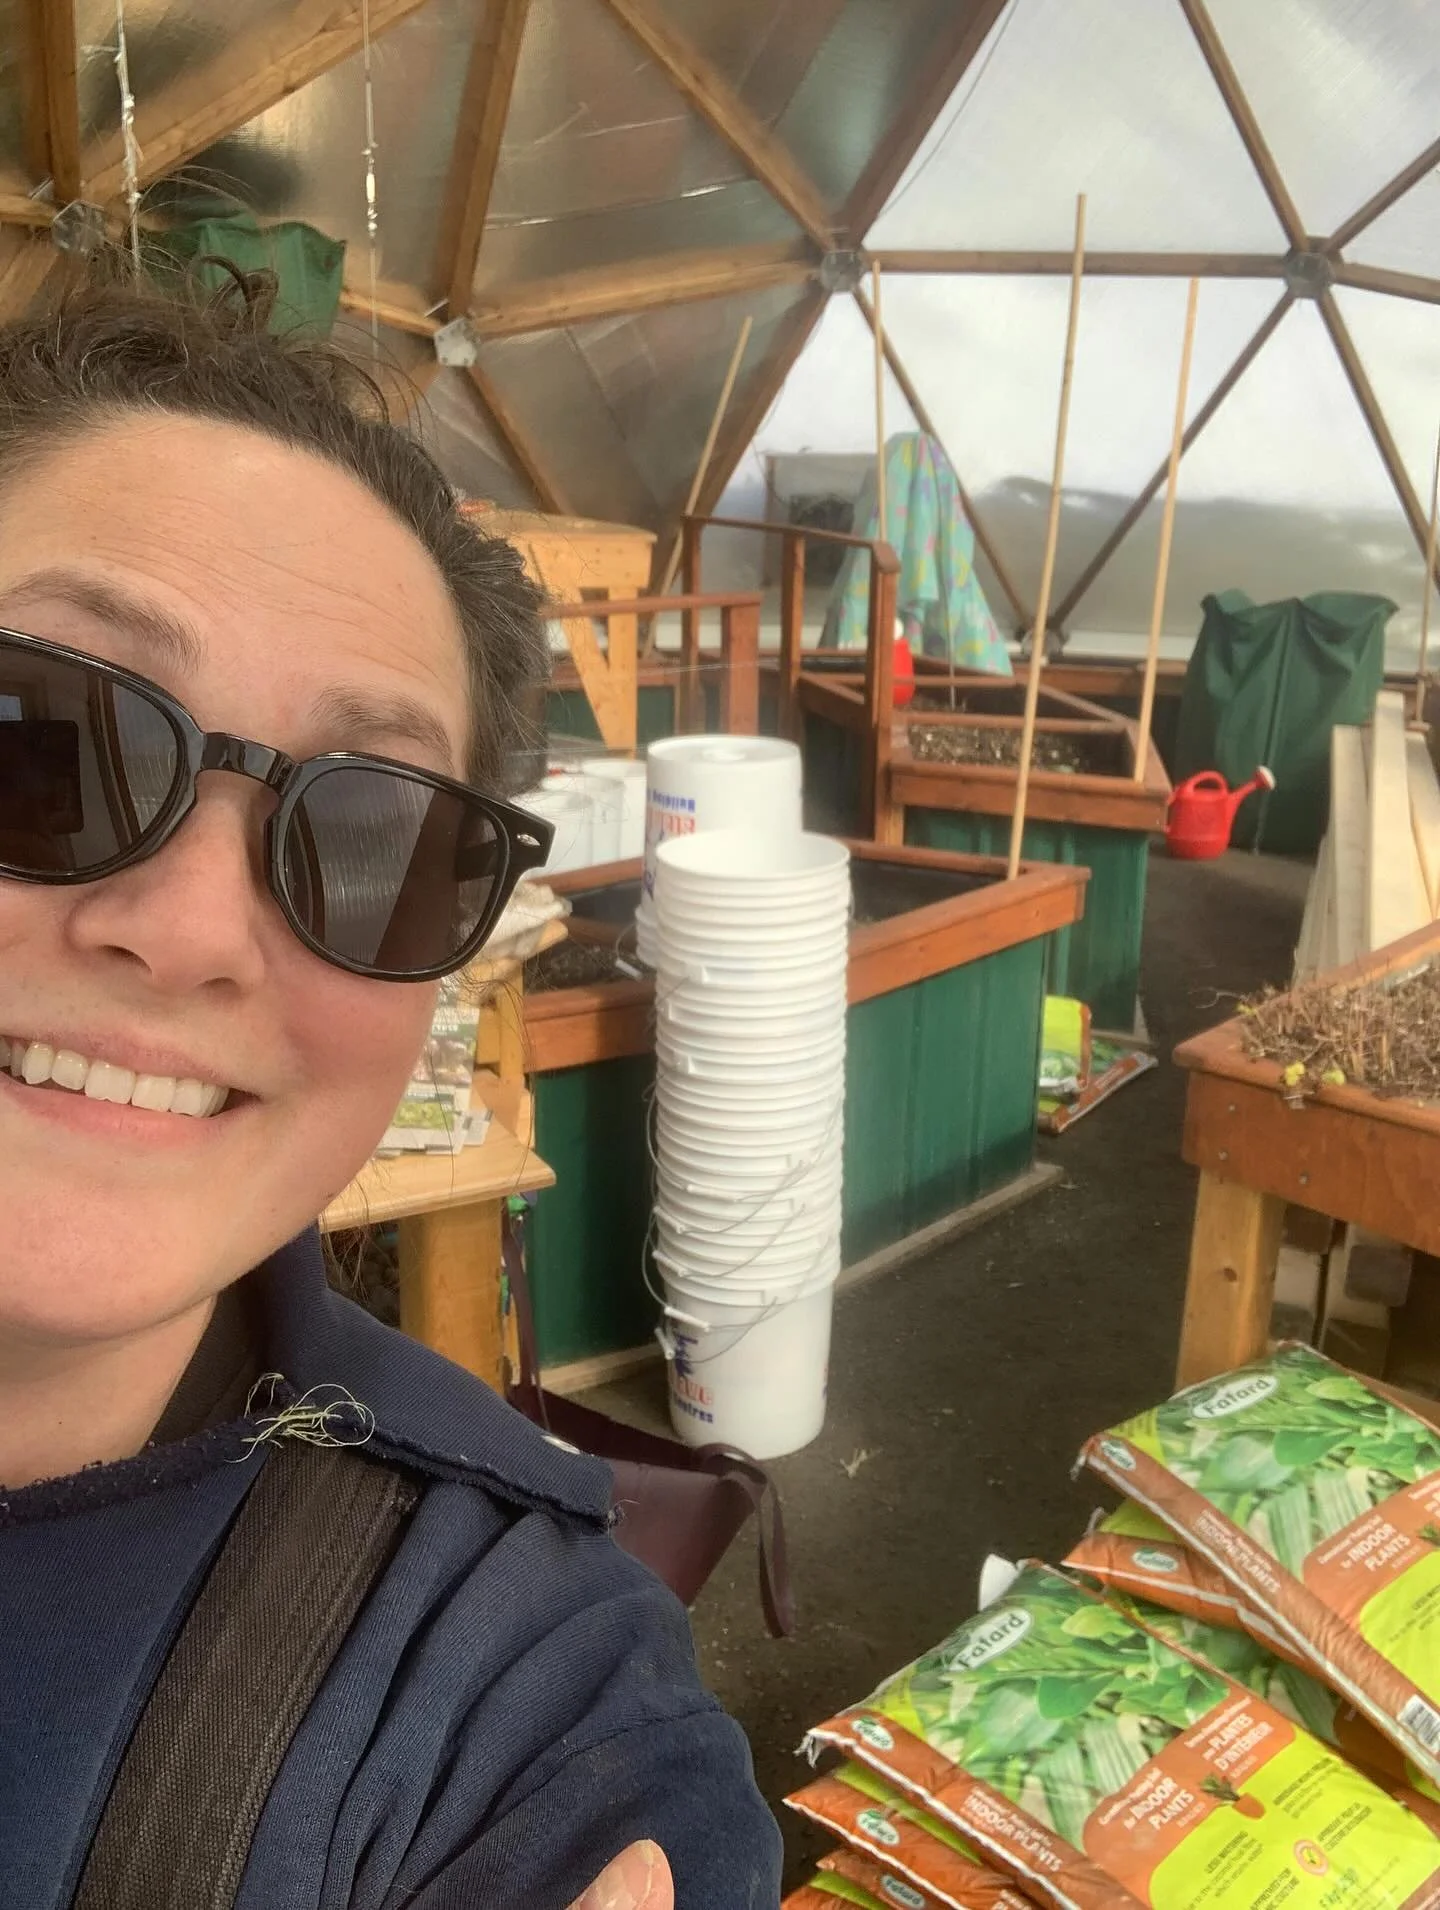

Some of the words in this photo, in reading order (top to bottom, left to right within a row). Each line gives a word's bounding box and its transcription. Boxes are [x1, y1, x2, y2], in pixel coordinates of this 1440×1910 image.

[1348, 1523, 1396, 1561] INDOOR
[1364, 1533, 1411, 1571] PLANTS
[957, 1613, 1025, 1668] Fafard
[1208, 1712, 1255, 1750] PLANTES
[1129, 1776, 1179, 1817] INDOOR
[1147, 1788, 1195, 1831] PLANTS
[962, 1794, 1016, 1837] INDOOR
[1011, 1830, 1063, 1872] PLANTS
